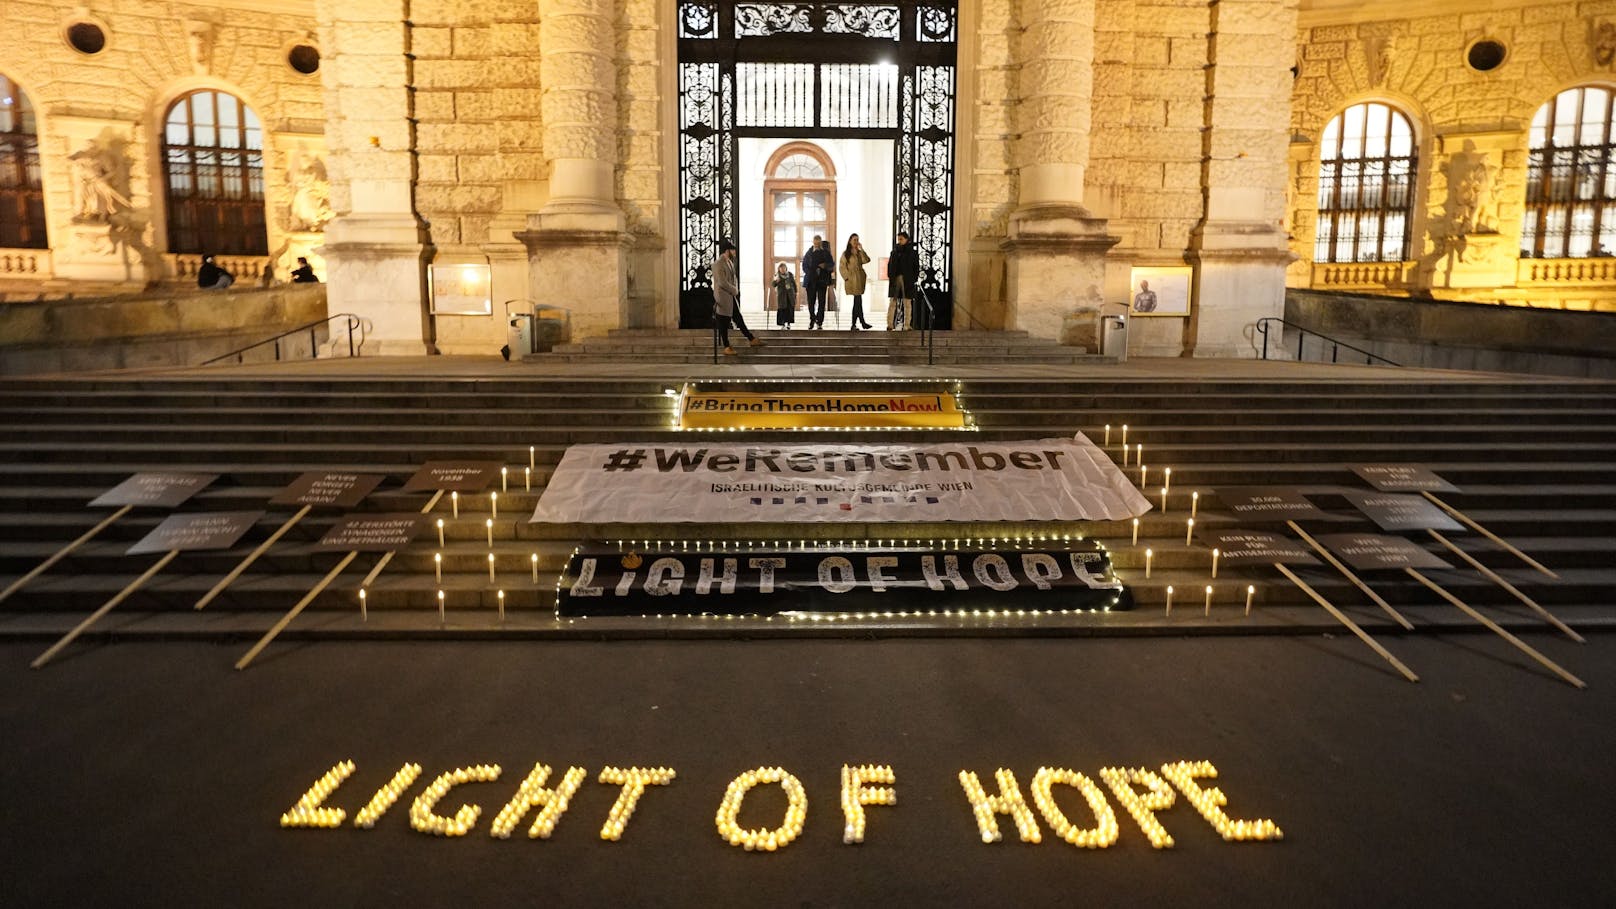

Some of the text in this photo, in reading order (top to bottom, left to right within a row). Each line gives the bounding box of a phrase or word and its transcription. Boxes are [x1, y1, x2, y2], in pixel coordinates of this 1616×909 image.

[602, 446, 1065, 473] #WeRemember
[324, 473, 358, 482] NEVER
[430, 467, 482, 476] November
[711, 480, 974, 493] ISRAELITISCHE KULUSGEMINDE WIEN
[818, 556, 899, 593] OF
[921, 553, 1122, 591] HOPE
[280, 758, 1284, 851] LIGHT OF HOPE
